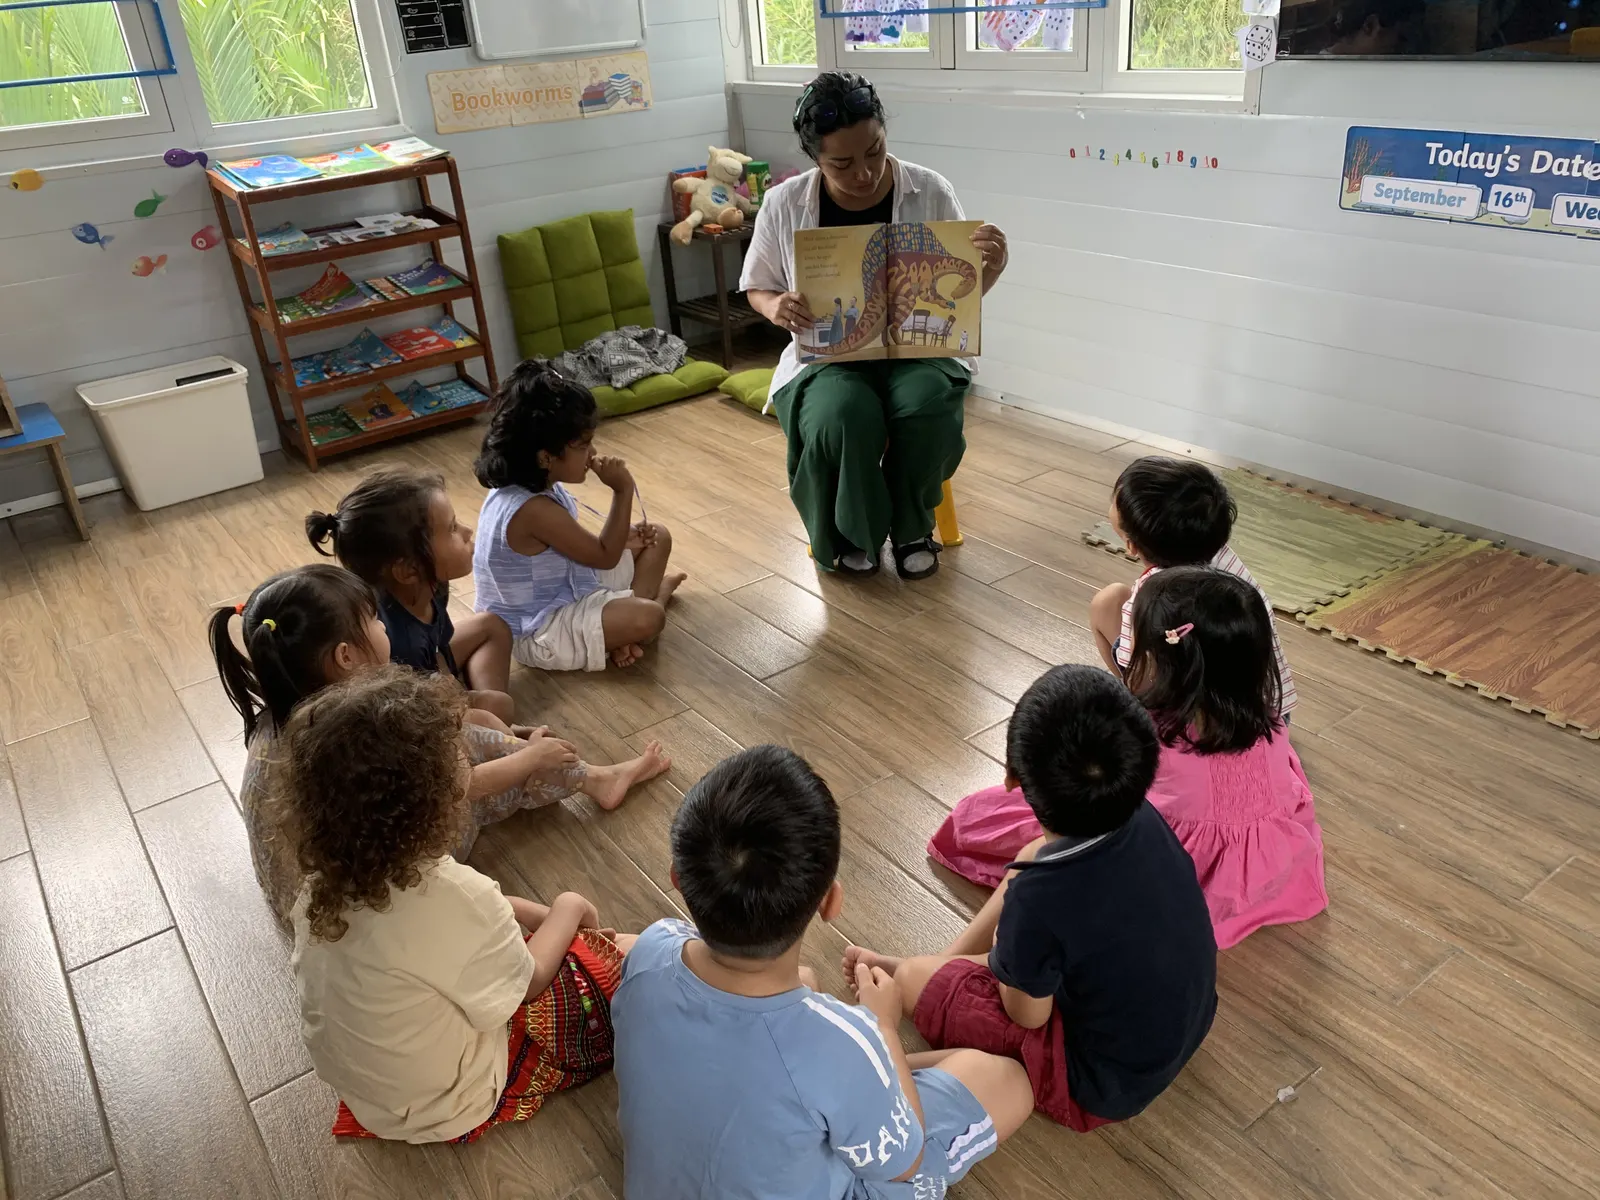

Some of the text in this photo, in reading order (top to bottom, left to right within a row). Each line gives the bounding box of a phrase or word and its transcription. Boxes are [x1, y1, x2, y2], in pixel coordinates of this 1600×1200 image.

[451, 85, 573, 113] Bookworms
[1069, 148, 1076, 158] 0
[1085, 145, 1091, 157] 1
[1099, 149, 1105, 160] 2
[1113, 153, 1120, 166] 3
[1125, 149, 1132, 160] 4
[1139, 151, 1146, 164] 5
[1152, 157, 1159, 169] 6
[1165, 151, 1171, 164] 7
[1177, 150, 1184, 162] 8
[1190, 156, 1197, 168] 9
[1425, 142, 1600, 181] Today's Date
[1374, 182, 1600, 220] September 16th We
